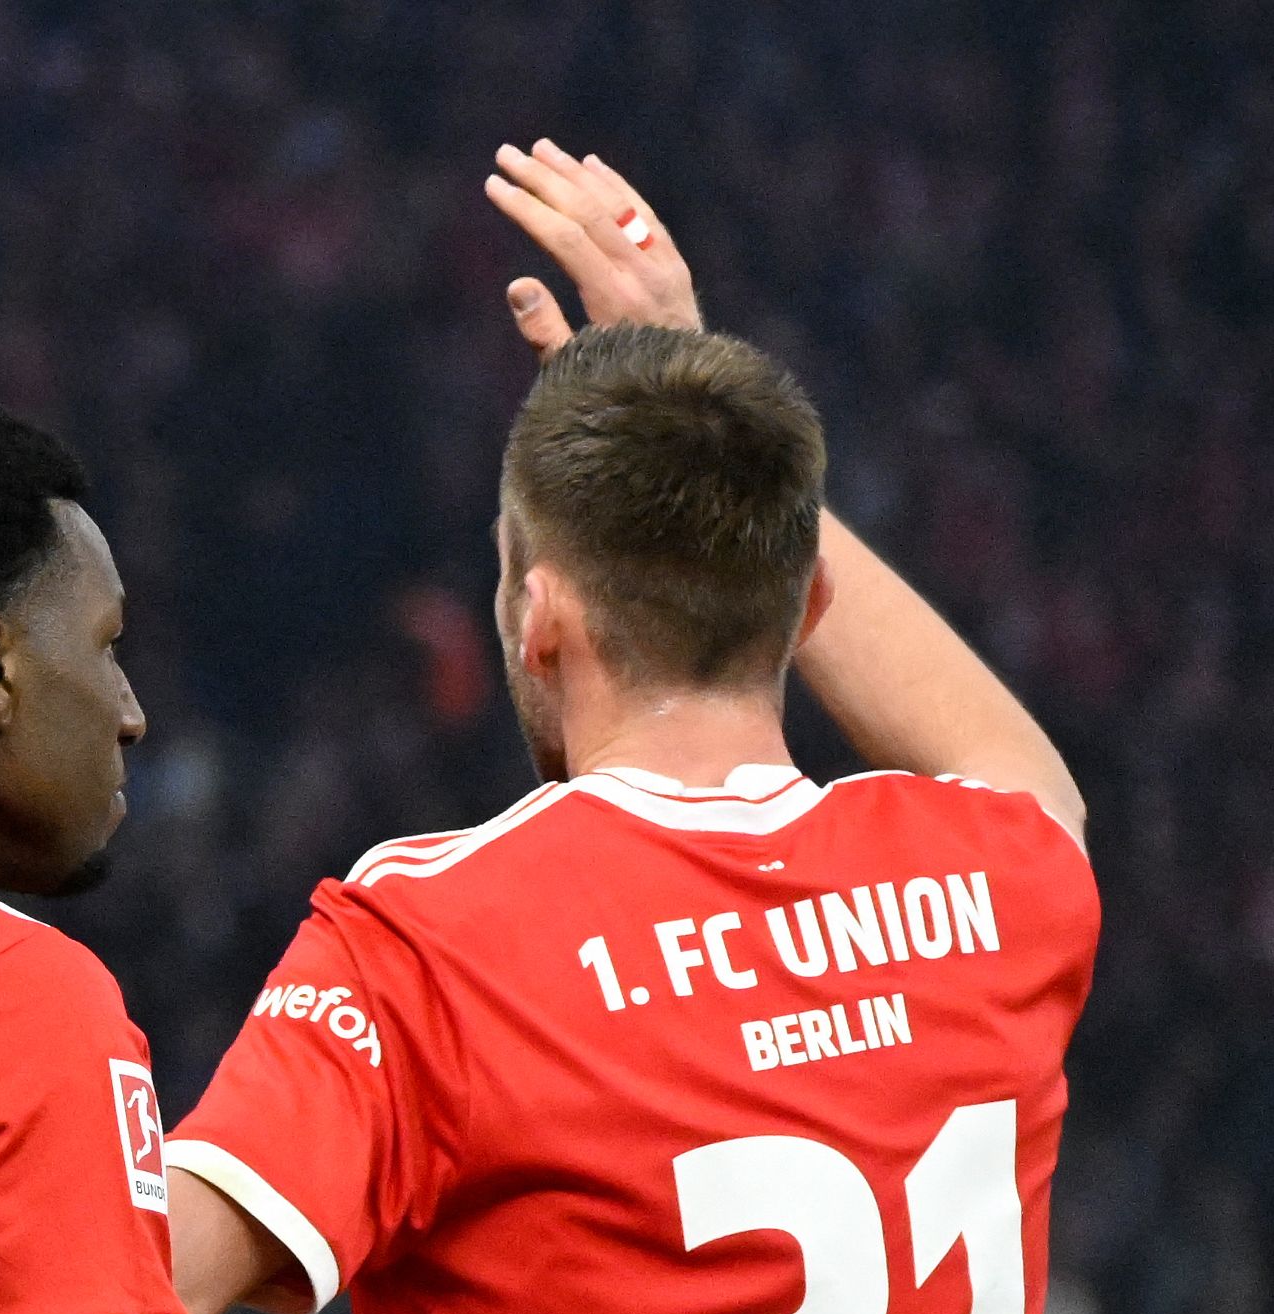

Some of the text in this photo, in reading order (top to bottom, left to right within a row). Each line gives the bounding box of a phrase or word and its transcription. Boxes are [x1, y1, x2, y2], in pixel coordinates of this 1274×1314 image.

[577, 871, 1001, 1012] 1. FC UNION
[252, 983, 382, 1068] wefox
[740, 992, 913, 1072] BERLIN
